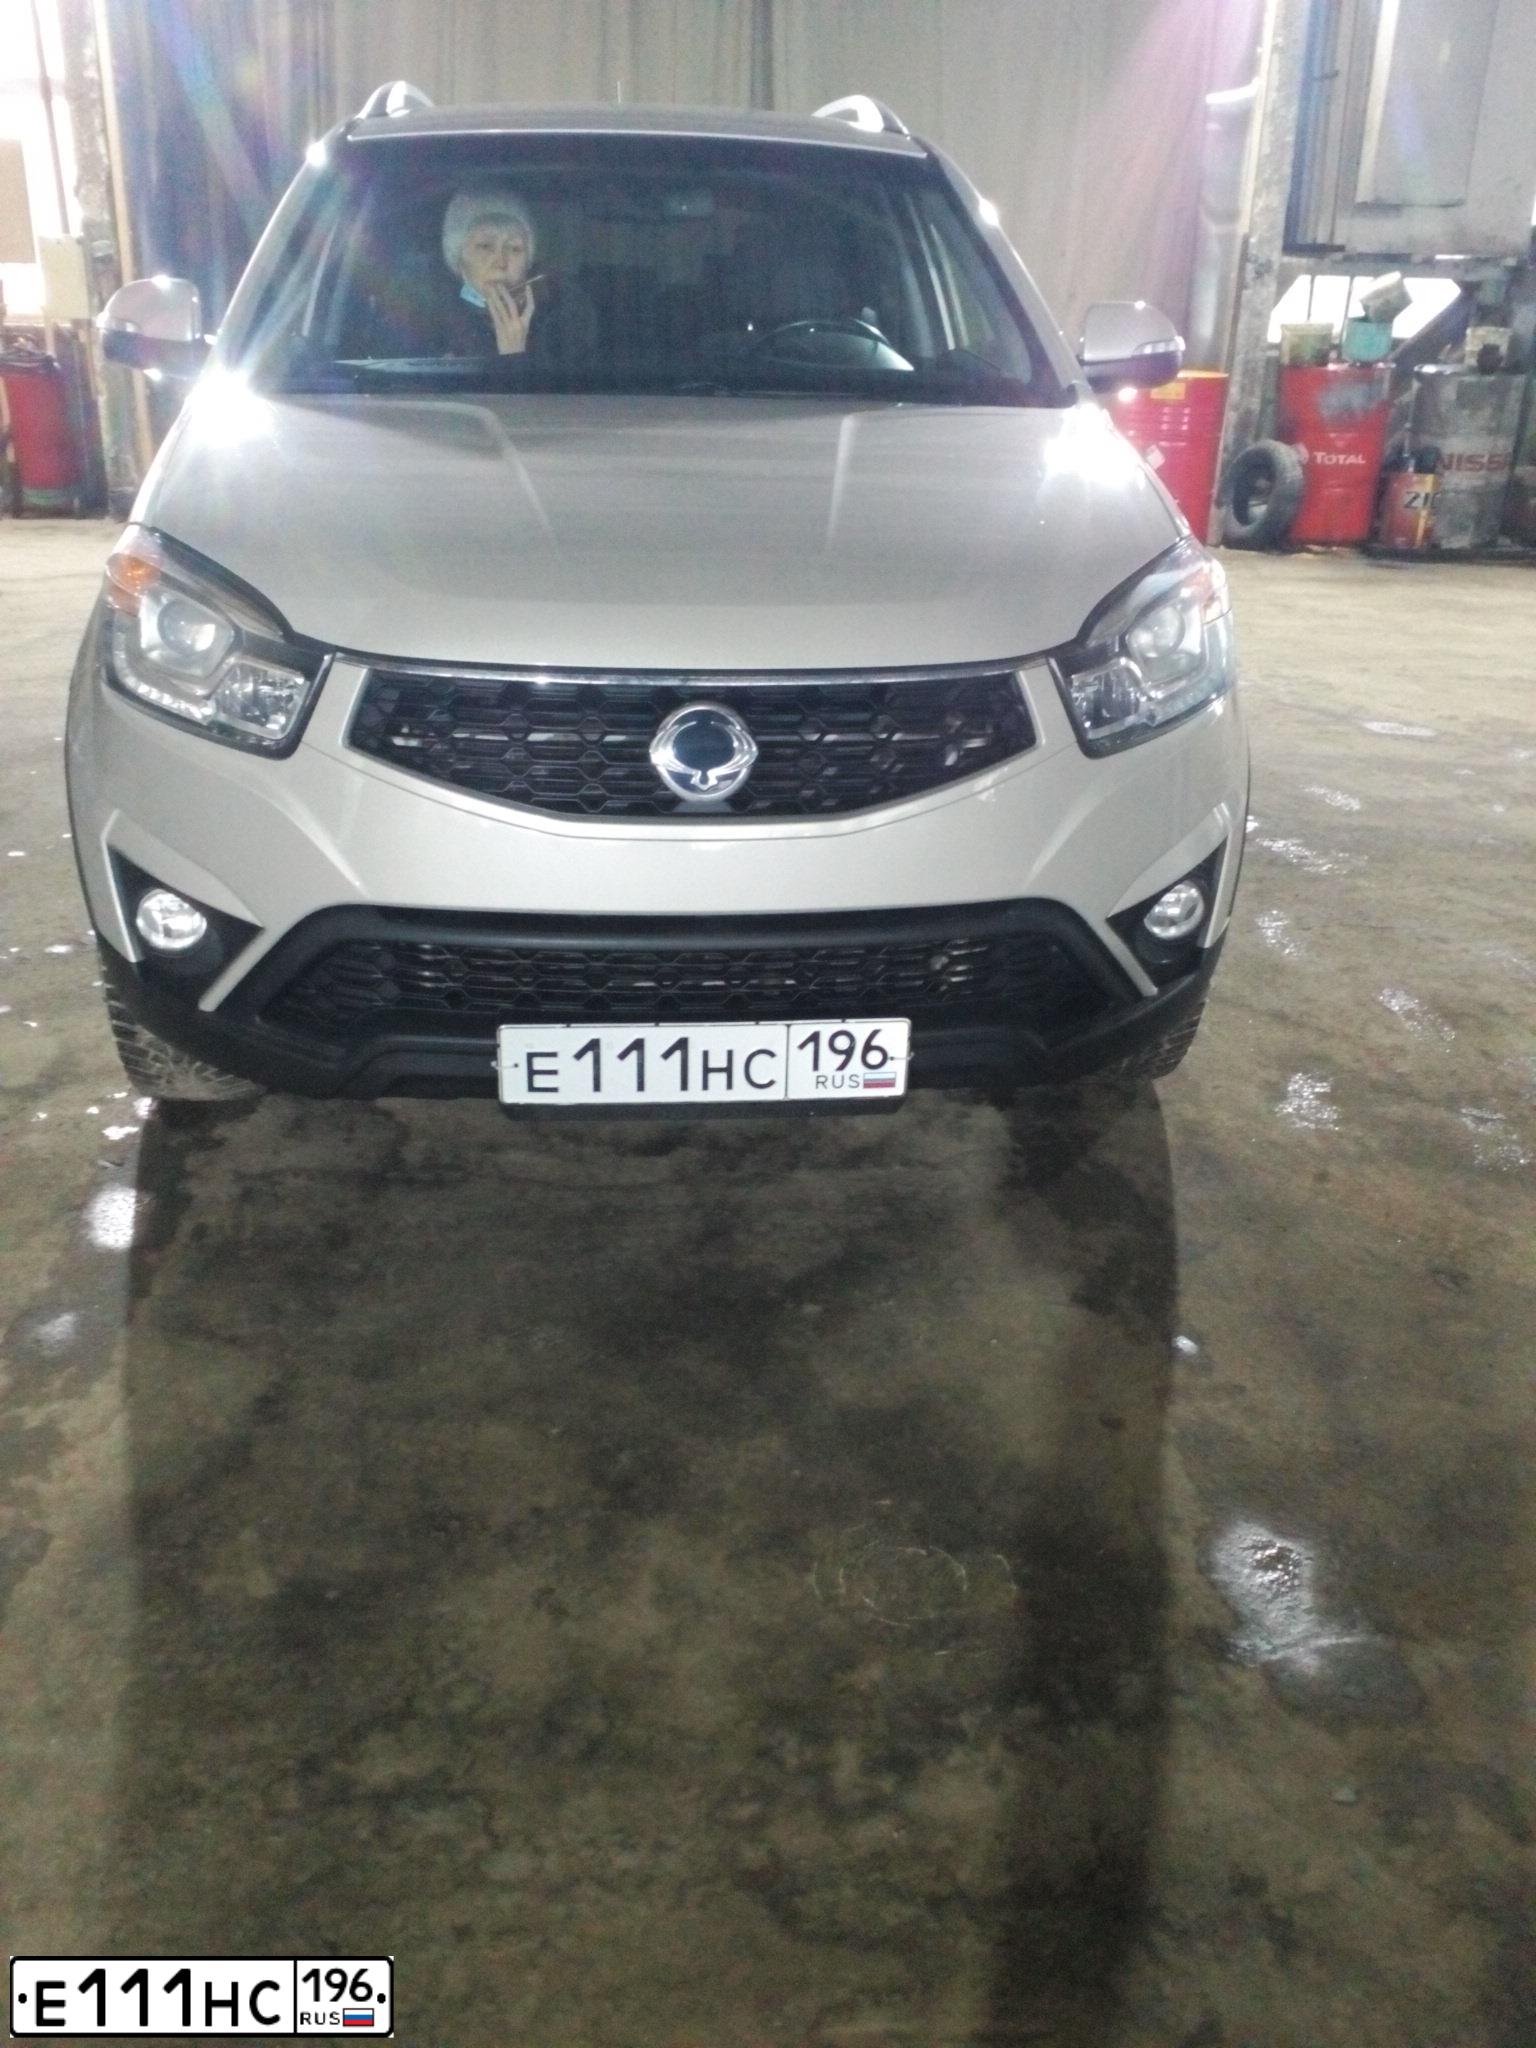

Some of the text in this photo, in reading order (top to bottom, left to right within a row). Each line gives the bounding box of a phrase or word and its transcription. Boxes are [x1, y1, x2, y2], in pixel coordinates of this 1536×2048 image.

[1313, 451, 1366, 465] TOTAL
[797, 1028, 889, 1071] 196
[815, 1073, 860, 1089] RUS
